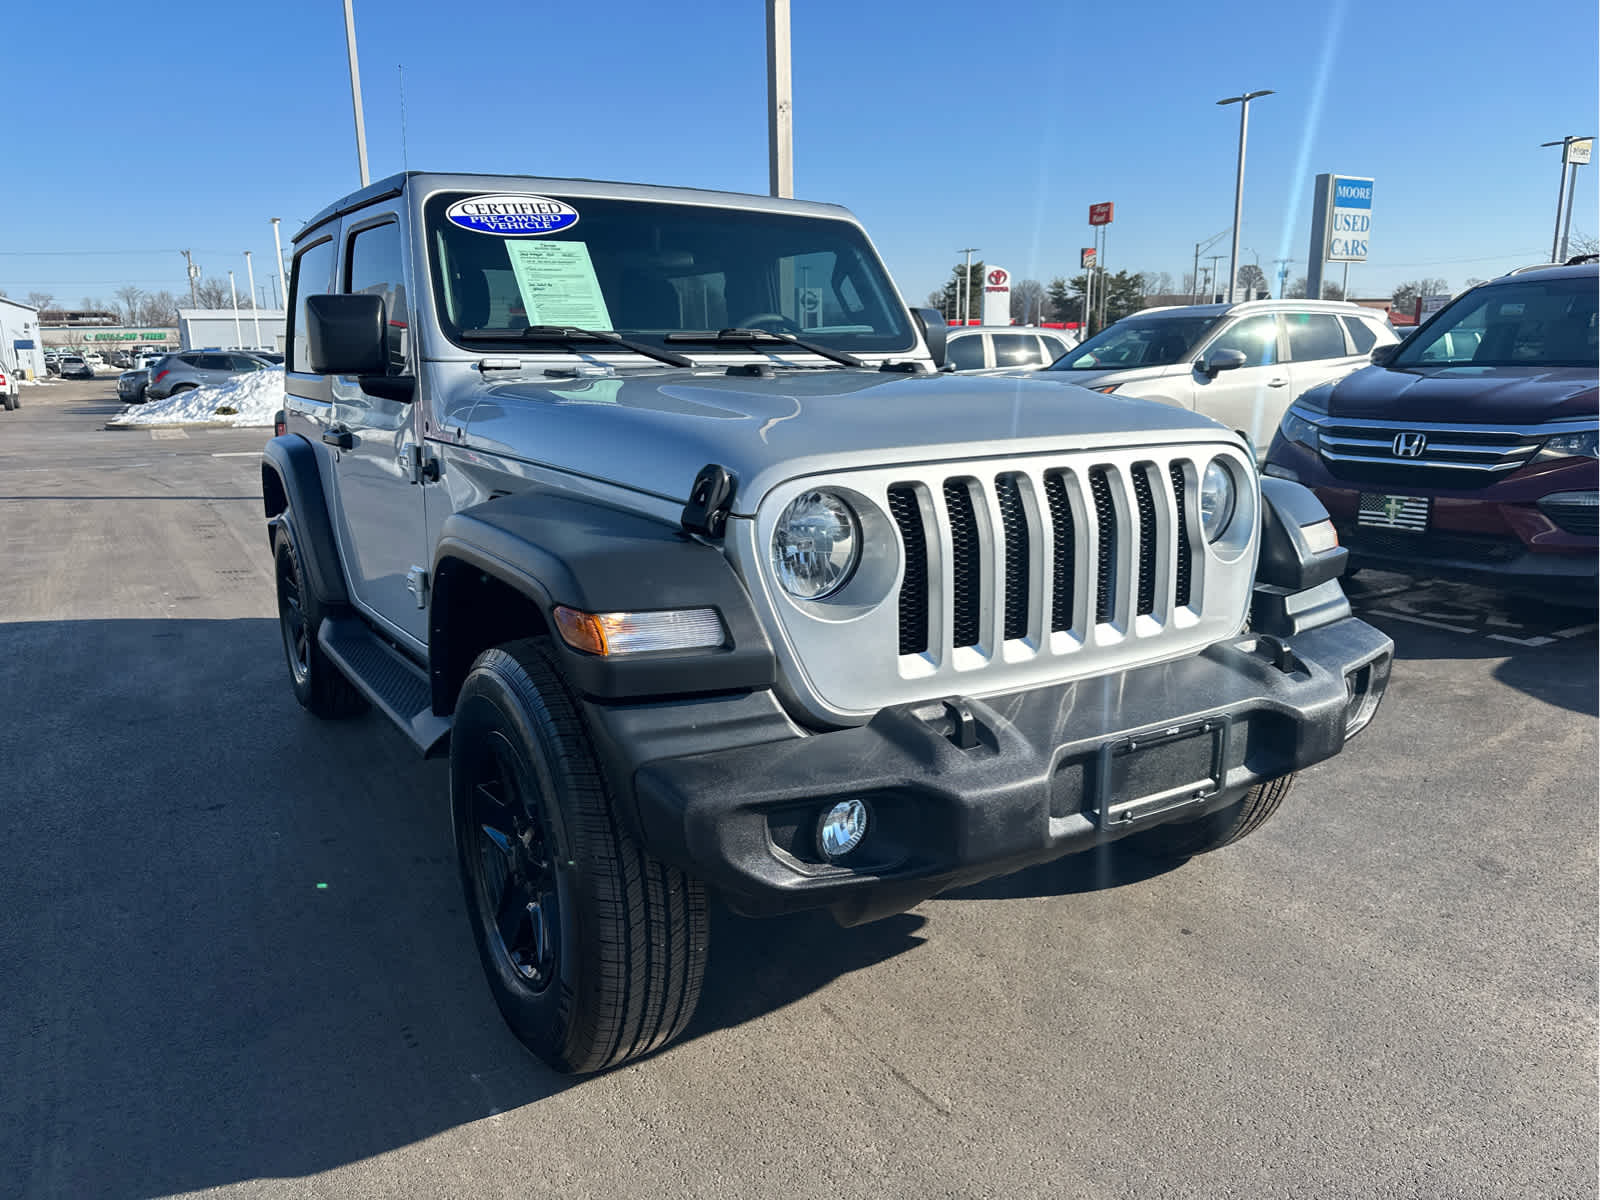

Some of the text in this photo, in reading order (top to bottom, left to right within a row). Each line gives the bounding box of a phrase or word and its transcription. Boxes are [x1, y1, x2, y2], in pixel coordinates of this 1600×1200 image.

[1337, 185, 1371, 200] MOORE
[461, 203, 562, 215] CERTIFIED
[470, 215, 561, 223] PRE-OWNED
[1334, 214, 1370, 232] USED
[487, 222, 552, 230] VEHICLE
[1331, 238, 1368, 256] CARS
[95, 332, 167, 341] DOLLAR TREE
